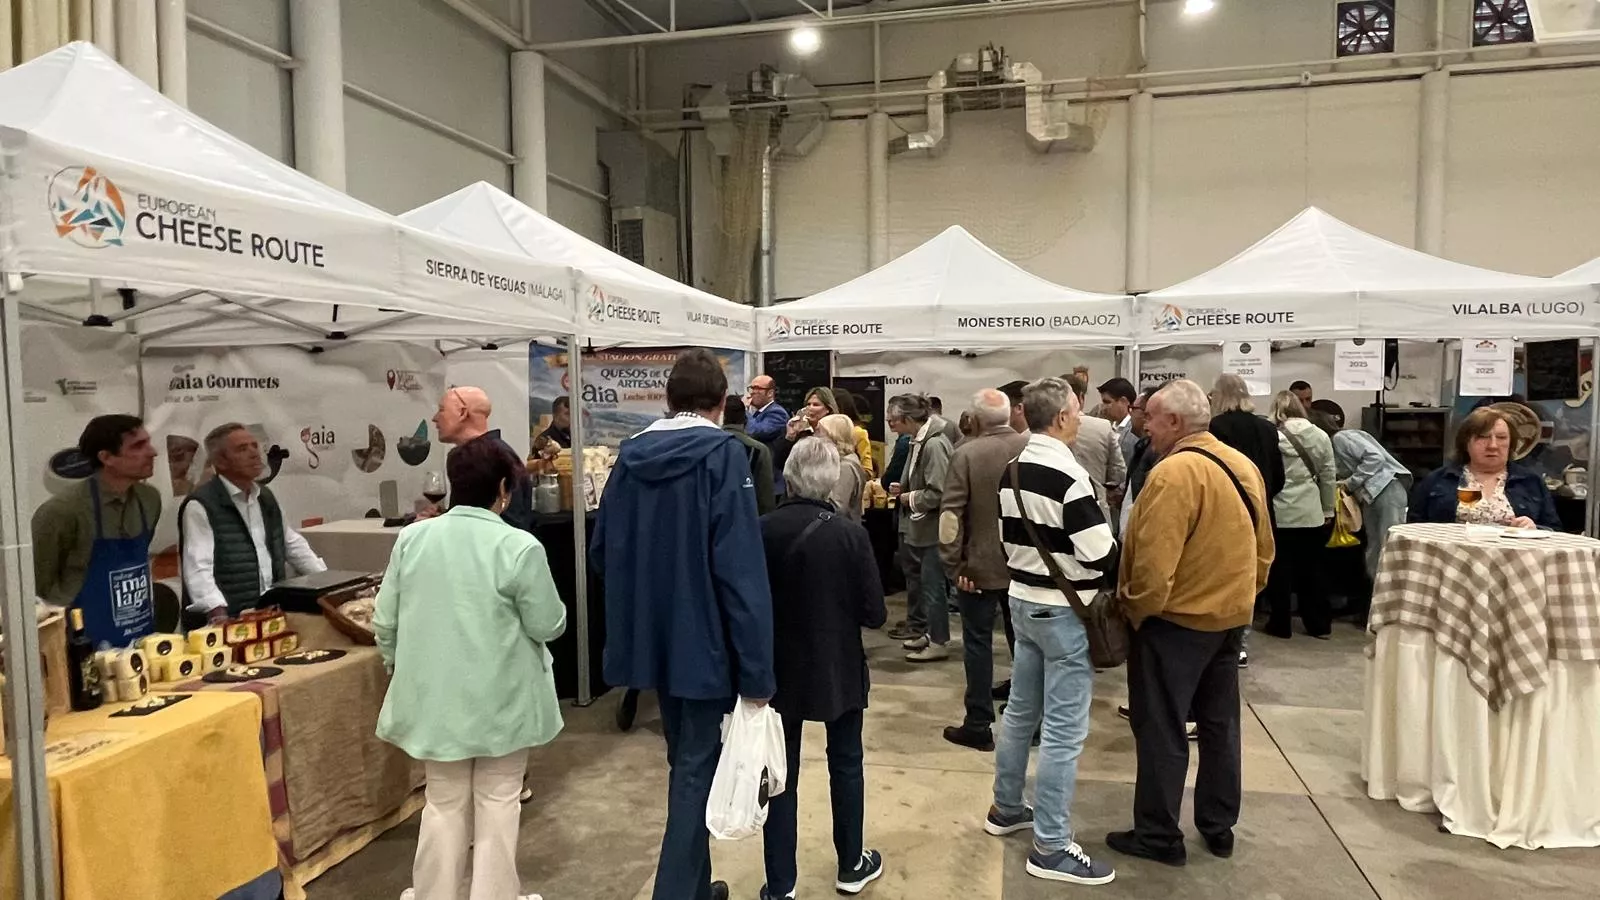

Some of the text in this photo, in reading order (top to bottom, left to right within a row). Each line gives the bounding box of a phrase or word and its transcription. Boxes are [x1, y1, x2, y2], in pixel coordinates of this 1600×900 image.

[137, 194, 217, 222] EUROPEAN
[136, 212, 325, 267] CHEESE ROUTE
[426, 259, 469, 281] SIERRA
[471, 270, 485, 286] DE
[487, 274, 526, 295] YEGUAS
[606, 304, 661, 325] CHEESE ROUTE
[1452, 302, 1585, 316] VILALBA (LUGO)
[958, 314, 1121, 329] MONESTERIO (BADAJOZ)
[1186, 312, 1294, 326] CHEESE ROUTE
[794, 324, 882, 336] CHEESE ROUTE
[206, 374, 280, 389] Gourmets
[601, 368, 648, 380] QUESOS
[617, 380, 665, 389] ARTESAN
